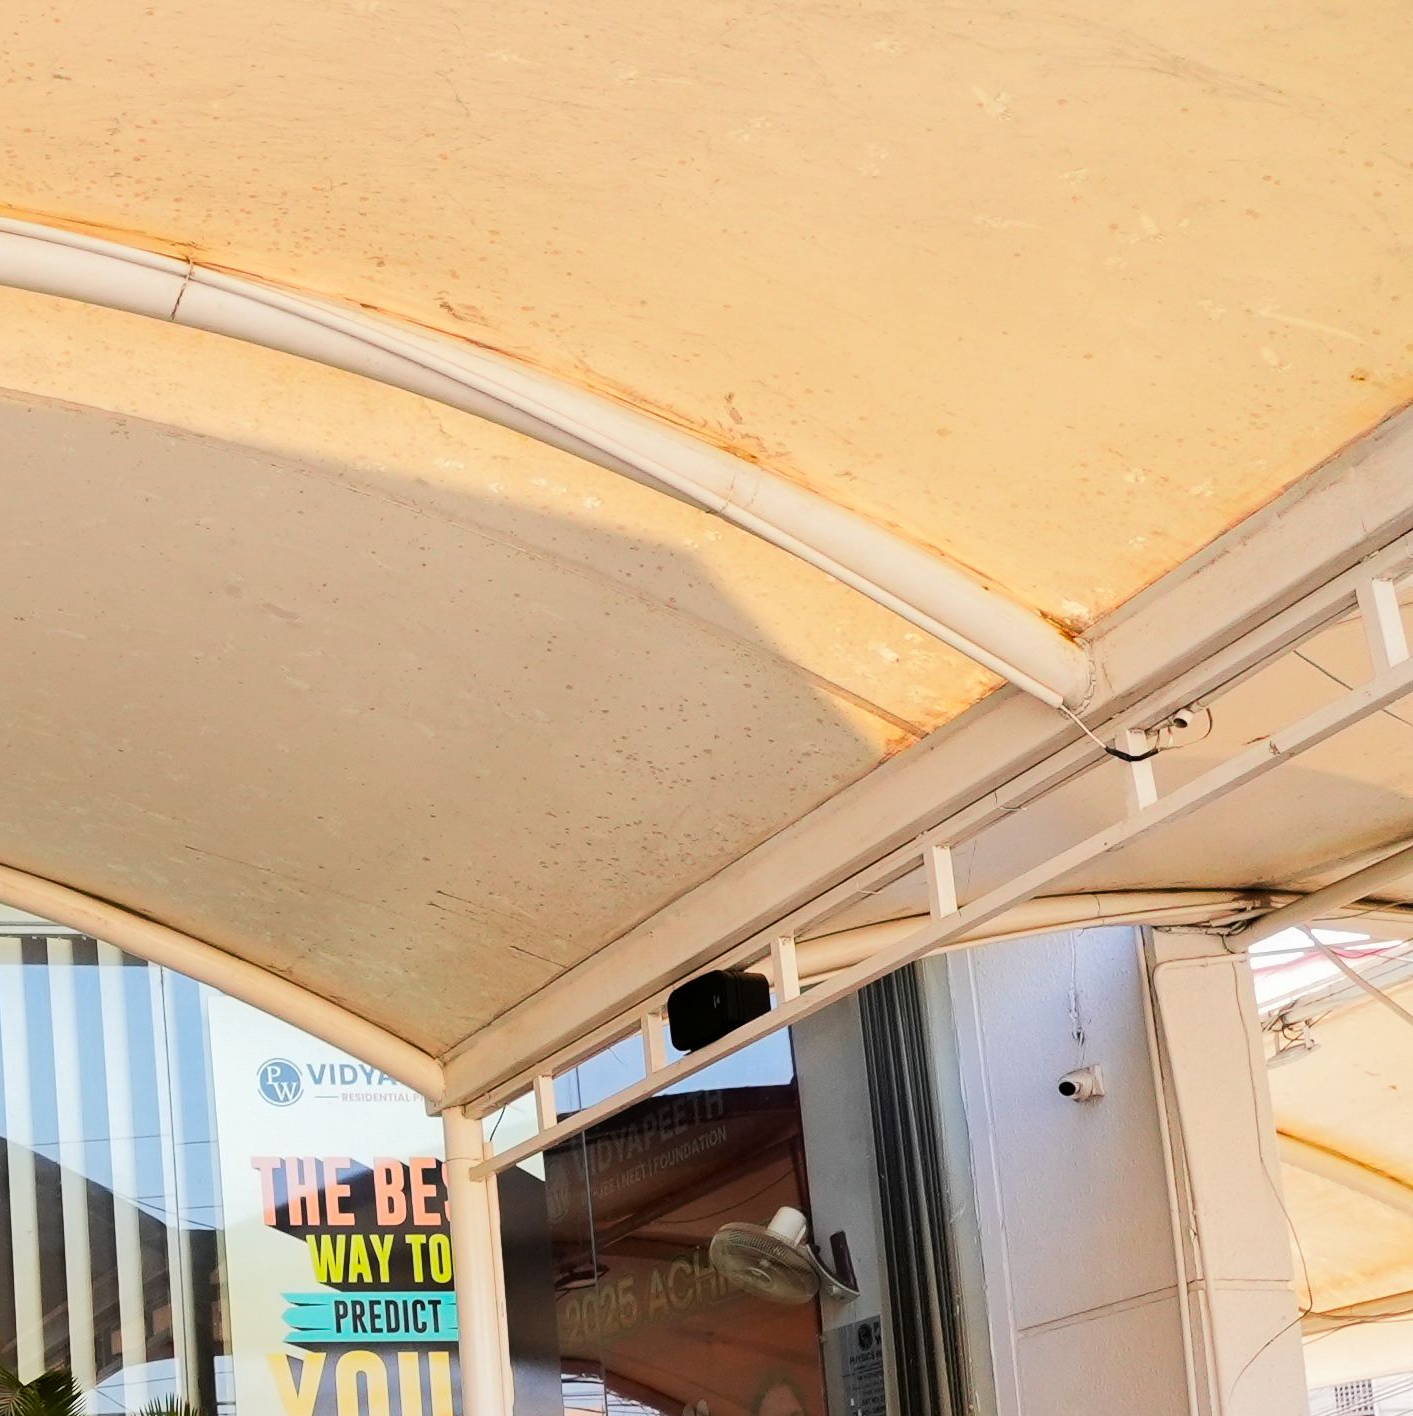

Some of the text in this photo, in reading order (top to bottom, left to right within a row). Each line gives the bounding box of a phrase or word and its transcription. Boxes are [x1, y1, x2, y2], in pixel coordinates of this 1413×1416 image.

[341, 1092, 410, 1102] RESIDENTIAL
[654, 1124, 728, 1177] FOUNDATION
[250, 1156, 356, 1226] THE
[306, 1233, 453, 1283] WAY TO
[334, 1299, 442, 1333] PREDICT
